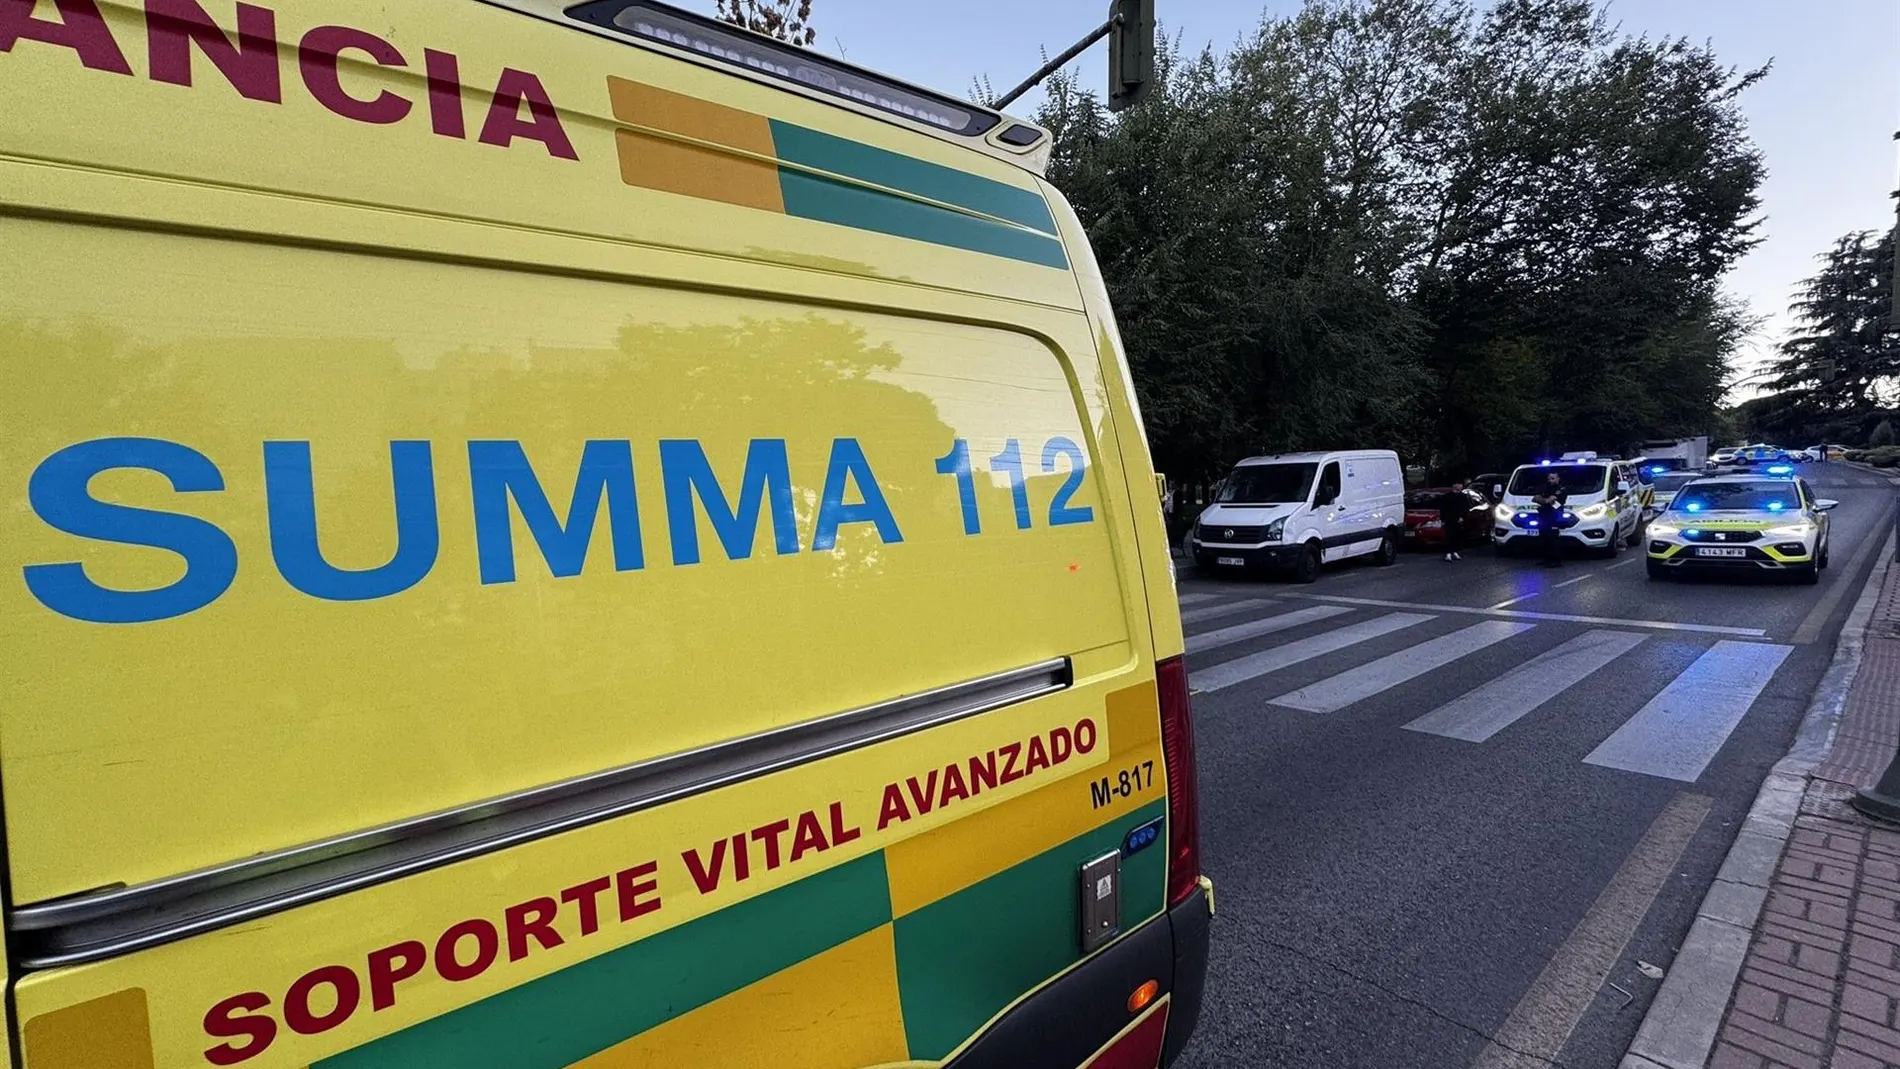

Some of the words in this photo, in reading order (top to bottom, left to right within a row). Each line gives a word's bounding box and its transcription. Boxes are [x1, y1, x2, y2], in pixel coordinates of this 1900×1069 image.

[23, 437, 904, 624] SUMMA
[935, 437, 1094, 535] 112
[1090, 760, 1153, 810] M-817
[202, 861, 662, 1067] SOPORTE
[681, 801, 862, 896] VITAL
[876, 718, 1097, 831] AVANZADO
